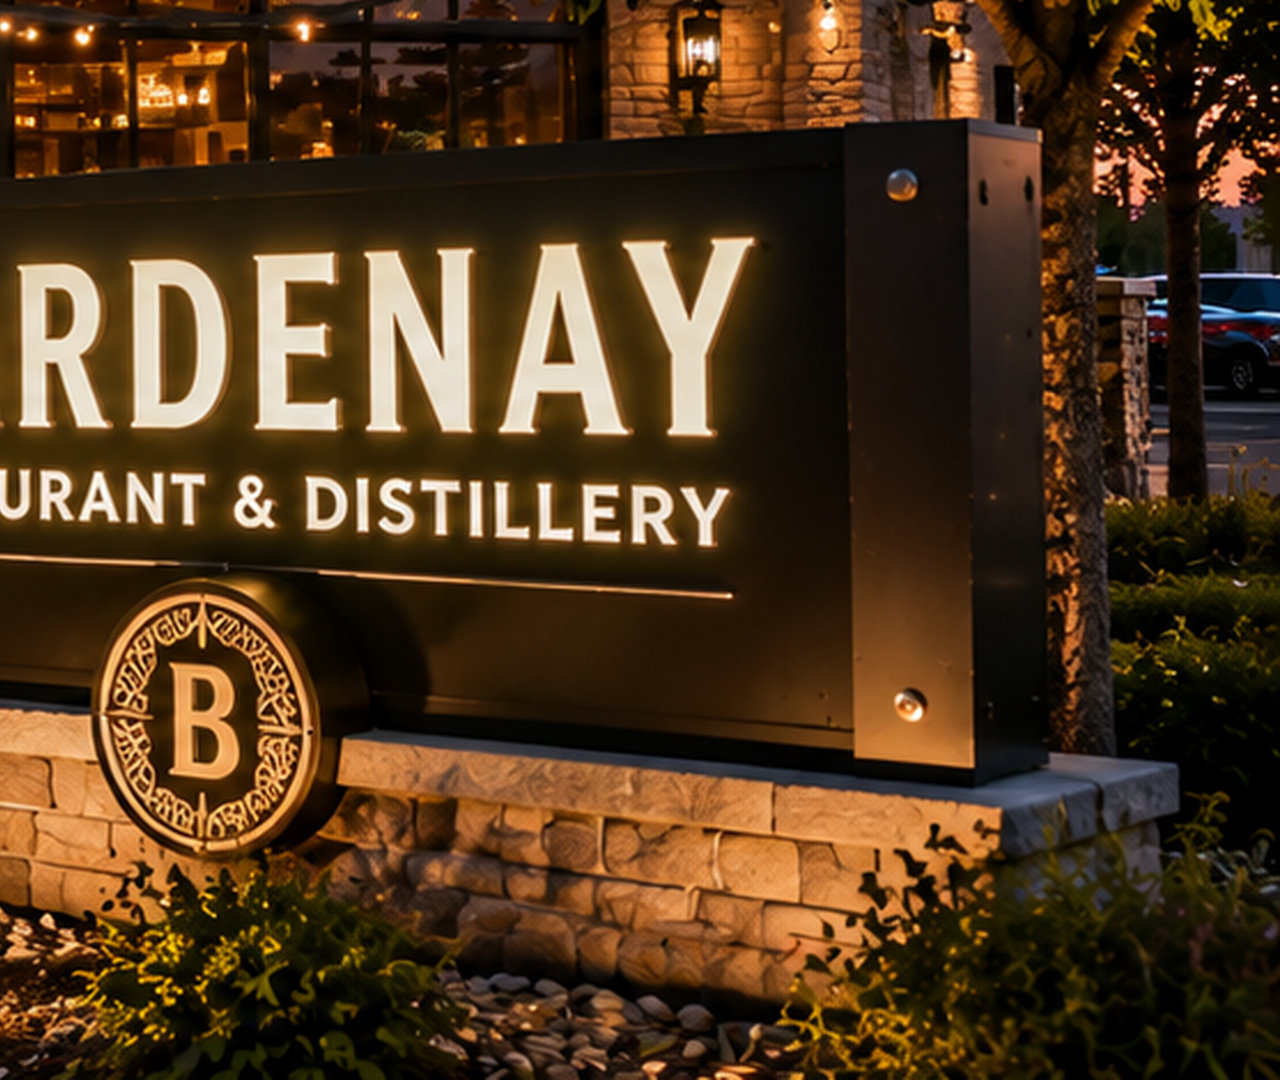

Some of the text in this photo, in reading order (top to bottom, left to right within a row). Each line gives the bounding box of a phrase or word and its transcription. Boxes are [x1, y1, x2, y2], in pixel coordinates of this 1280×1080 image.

[233, 474, 277, 530] &
[305, 476, 731, 548] DISTILLERY
[168, 662, 240, 780] B
